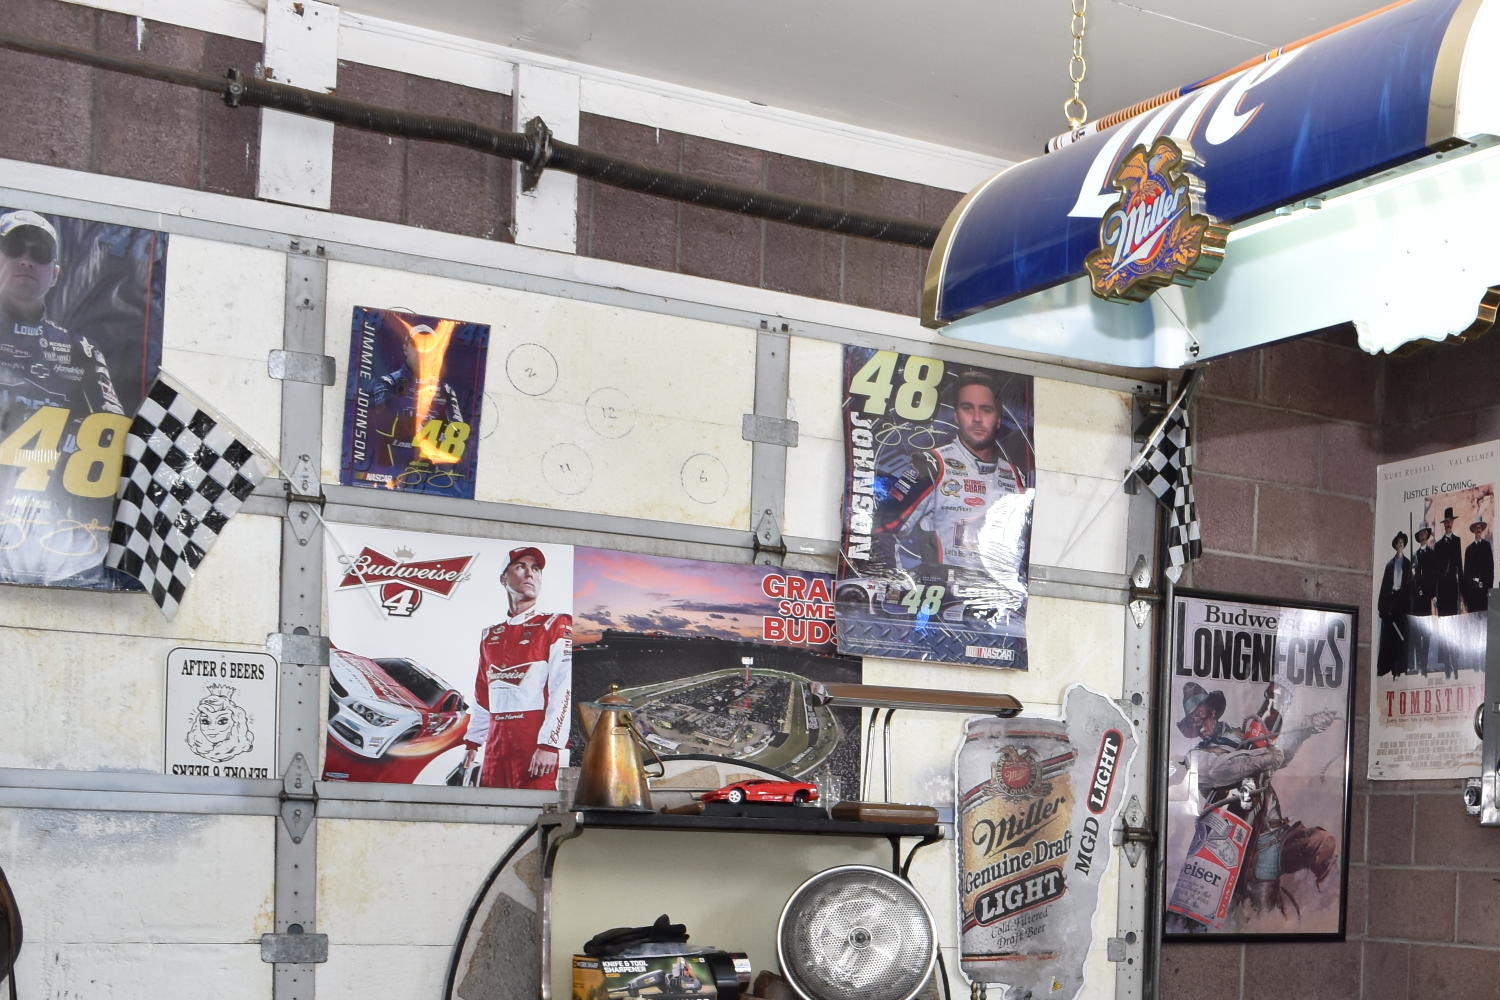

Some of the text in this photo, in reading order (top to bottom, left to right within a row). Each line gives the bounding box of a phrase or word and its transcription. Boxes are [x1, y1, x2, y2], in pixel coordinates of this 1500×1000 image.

[1103, 184, 1187, 268] Miller
[353, 321, 376, 461] JIMMIE JOHNSON
[848, 350, 945, 421] 48
[0, 405, 133, 498] 48
[412, 419, 471, 459] 48
[1449, 457, 1464, 466] VAL
[365, 473, 393, 483] NASCAR
[848, 411, 875, 561] JOHNSON
[337, 554, 471, 583] Budweiser
[382, 589, 416, 617] 4
[762, 573, 837, 603] GRA
[902, 584, 946, 616] 48
[778, 600, 836, 620] SOME
[981, 647, 1015, 661] NASCAR
[1175, 601, 1346, 689] LONGNECKS
[181, 659, 265, 680] AFTER 6 BEERS
[548, 689, 572, 746] Budweiser
[1386, 686, 1485, 717] TOMBSTON
[1090, 737, 1120, 809] LIGHT
[971, 796, 1066, 858] Miller
[964, 830, 1073, 894] Genuine Draft
[1074, 816, 1100, 877] MGD
[980, 871, 1060, 922] LIGHT
[991, 907, 1049, 939] Cold Filtered
[997, 923, 1047, 947] Draft Beer
[602, 960, 625, 968] KNIFE
[604, 966, 647, 974] SHARPENER
